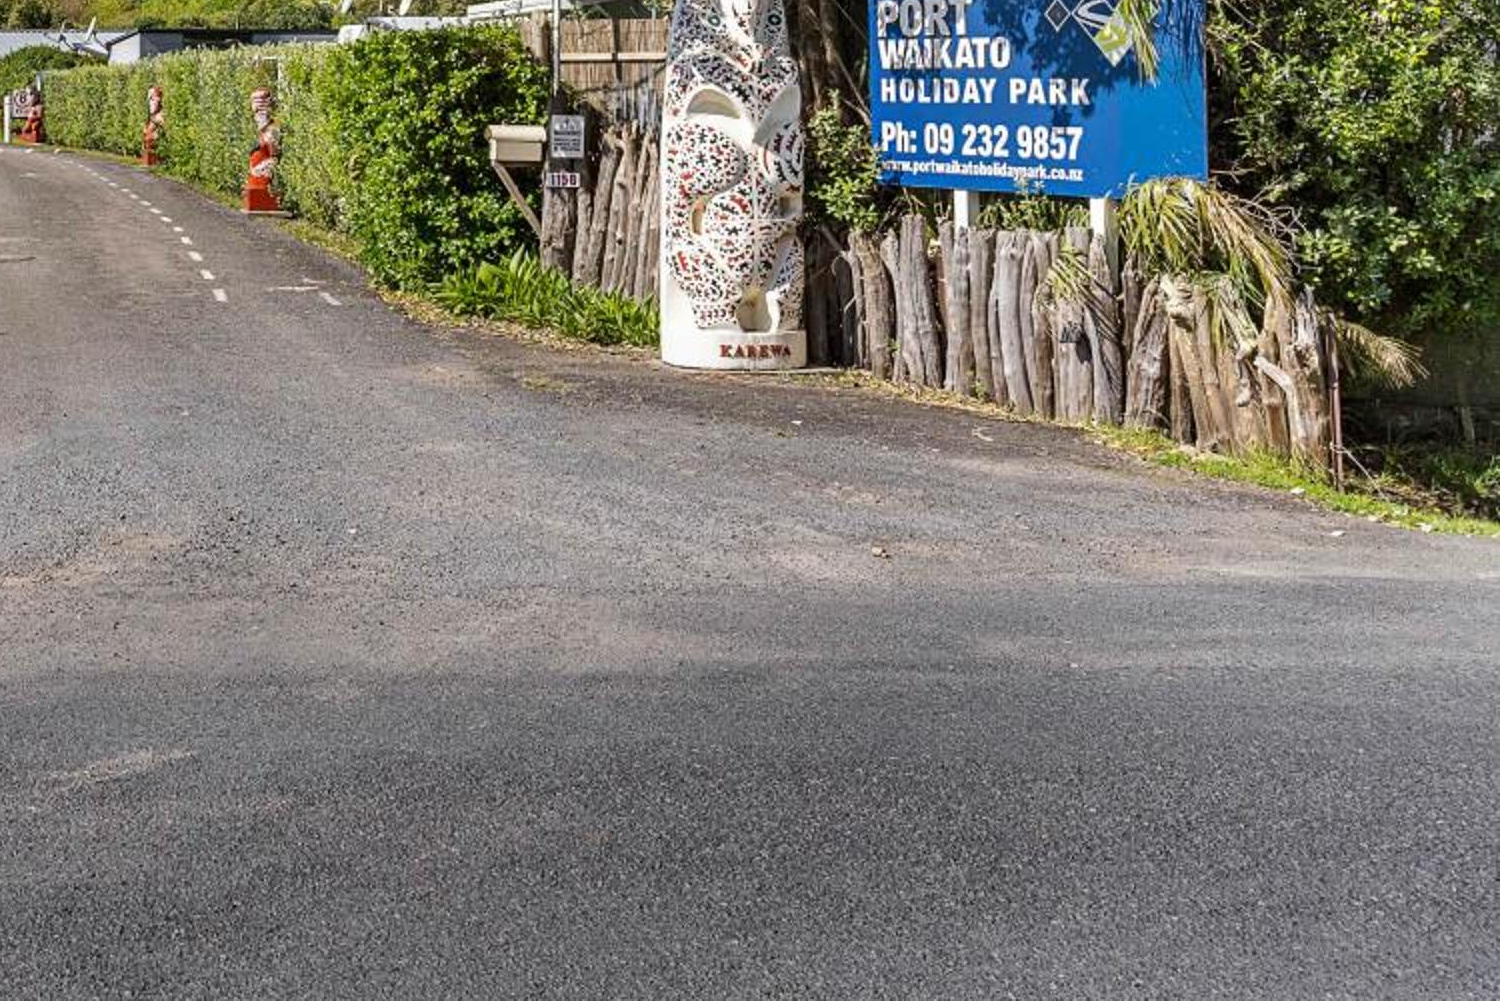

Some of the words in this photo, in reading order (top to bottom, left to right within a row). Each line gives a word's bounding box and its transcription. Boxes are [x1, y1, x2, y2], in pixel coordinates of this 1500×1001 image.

[877, 36, 1011, 70] WAIKATO
[881, 78, 997, 104] HOLIDAY
[1009, 78, 1091, 105] PARK
[881, 122, 917, 154] Ph:
[924, 124, 954, 154] 09
[962, 125, 1009, 158] 232
[1017, 126, 1083, 160] 9857
[881, 159, 1084, 182] www.portwaikatoholidaypark.co.nz
[719, 344, 792, 359] KAREWA
